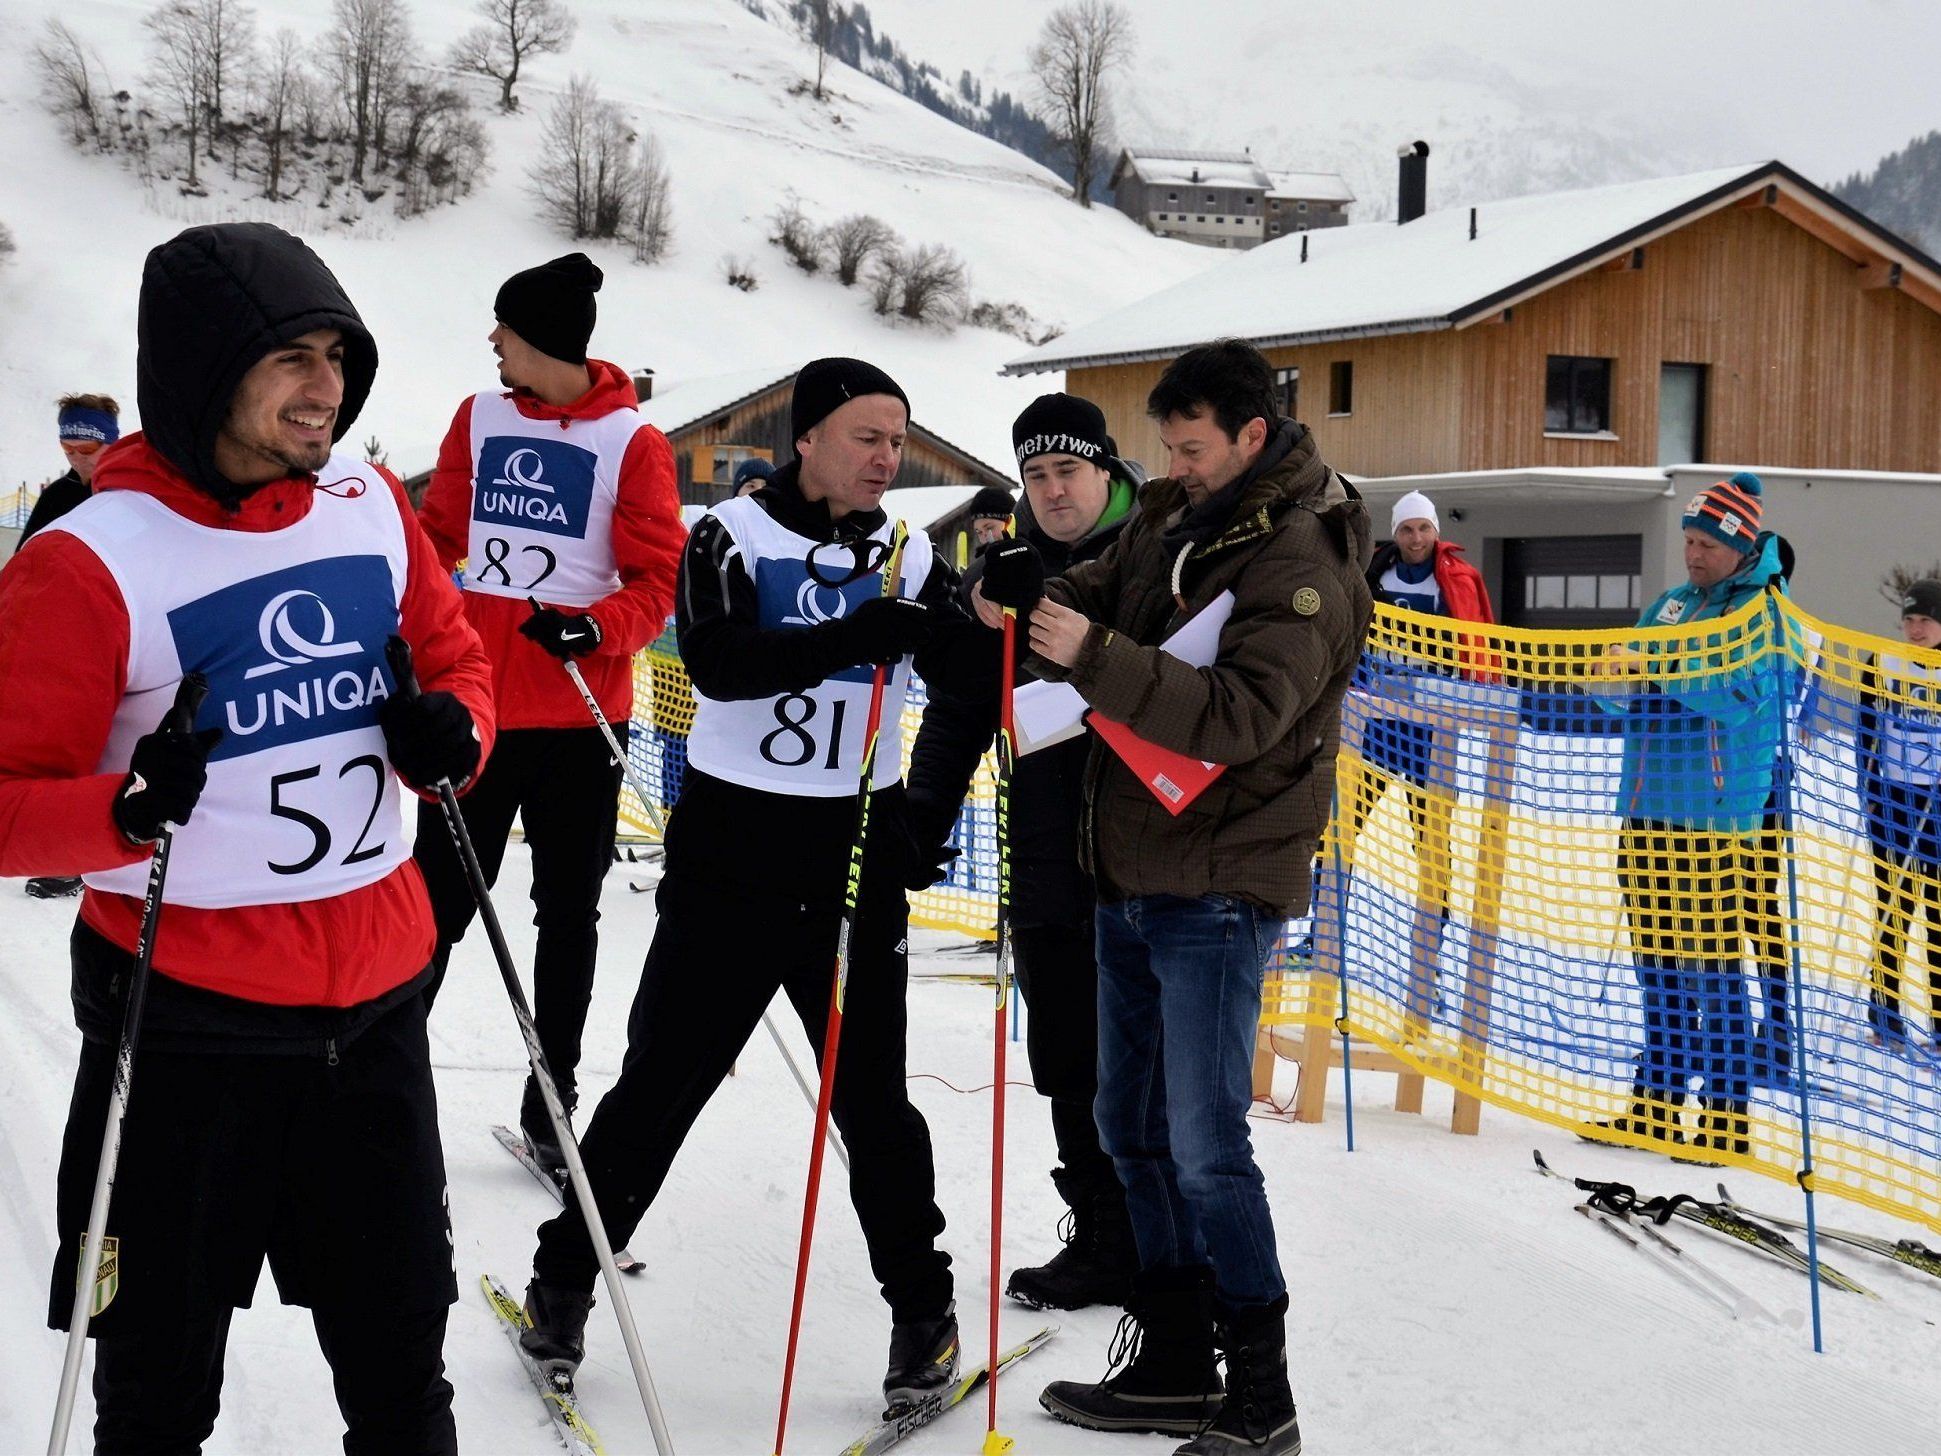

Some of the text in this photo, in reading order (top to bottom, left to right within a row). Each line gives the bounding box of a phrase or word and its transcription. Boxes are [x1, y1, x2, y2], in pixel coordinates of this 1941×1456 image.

[483, 491, 568, 525] UNIQA
[477, 538, 557, 589] 82
[225, 666, 390, 735] UNIQA
[584, 694, 606, 727] LEKI
[760, 694, 847, 770] 81
[267, 754, 386, 875] 52
[148, 837, 165, 886] EKI
[845, 845, 863, 908] LEKI
[1001, 845, 1011, 906] LEKI
[1704, 1214, 1760, 1246] FISCHER
[1893, 1250, 1941, 1278] FISCHE
[897, 1396, 942, 1440] FISCHER
